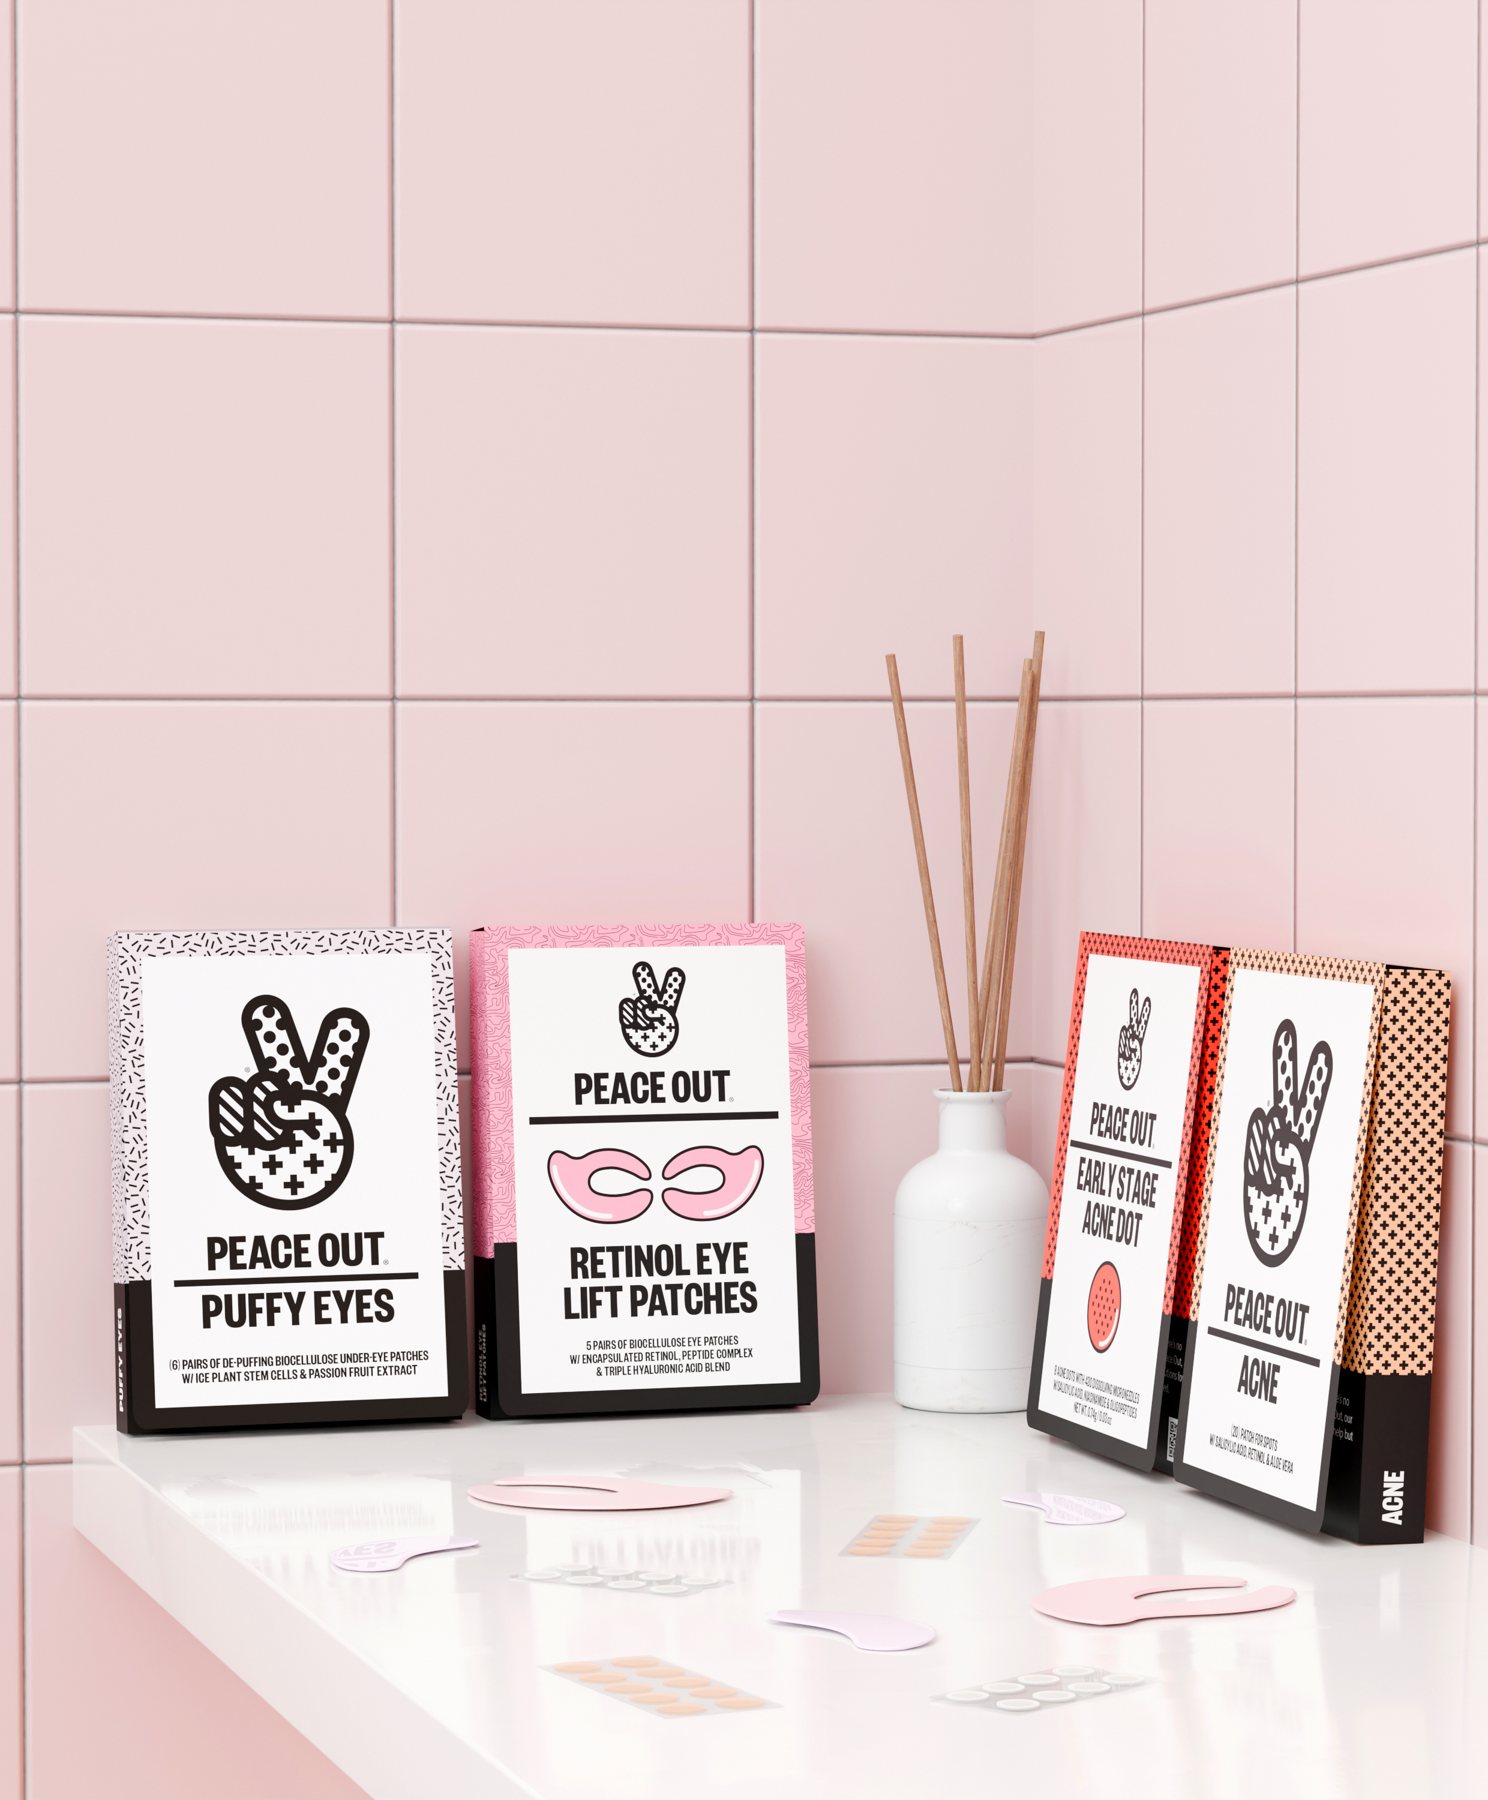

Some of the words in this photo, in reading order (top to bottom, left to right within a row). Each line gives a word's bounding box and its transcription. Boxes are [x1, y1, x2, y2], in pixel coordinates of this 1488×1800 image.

[574, 1071, 666, 1105] PEACE
[1090, 1101, 1130, 1142] PEACE
[1129, 1110, 1157, 1148] OUT
[1076, 1156, 1117, 1198] EARLY
[1116, 1165, 1159, 1208] STAGE
[1082, 1200, 1116, 1241] ACNE
[1115, 1208, 1143, 1247] DOT
[207, 1234, 312, 1271] PEACE
[570, 1243, 691, 1279] RETINOL
[696, 1241, 749, 1275] EYE
[201, 1291, 306, 1329] PUFFY
[313, 1288, 395, 1325] EYES
[563, 1285, 623, 1320] LIFT
[630, 1280, 758, 1318] PATCHES
[1224, 1283, 1275, 1335] PEACE
[1275, 1298, 1310, 1345] OUT
[169, 1359, 180, 1371] (6)
[182, 1358, 209, 1370] PAIRS
[210, 1357, 221, 1369] OF
[222, 1355, 274, 1369] DE-PUFFING
[275, 1354, 339, 1366] BIOCELLULOSE
[340, 1352, 389, 1364] UNDER-EYE
[390, 1350, 429, 1362] PATCHES
[570, 1354, 580, 1364] W/
[582, 1352, 643, 1364] ENCAPSULATED
[645, 1351, 681, 1362] RETINOL,
[682, 1349, 715, 1360] PEPTIDE
[716, 1348, 754, 1359] COMPLEX
[586, 1341, 591, 1351] 5
[593, 1339, 616, 1350] PAIRS
[617, 1339, 627, 1349] OF
[629, 1337, 686, 1349] BIOCELLULOSE
[687, 1336, 701, 1347] EYE
[704, 1335, 739, 1346] PATCHES
[181, 1372, 193, 1384] W/
[195, 1372, 210, 1383] ICE
[211, 1371, 242, 1383] PLANT
[243, 1370, 269, 1382] STEM
[270, 1369, 298, 1381] CELLS
[299, 1369, 307, 1379] &
[309, 1367, 347, 1379] PASSION
[349, 1366, 375, 1377] FRUIT
[377, 1364, 418, 1376] EXTRACT
[596, 1366, 603, 1377] &
[604, 1365, 632, 1376] TRIPLE
[633, 1363, 684, 1375] HYALURONIC
[685, 1362, 703, 1373] ACID
[705, 1361, 731, 1372] BLEND
[1057, 1366, 1066, 1379] ACNE
[1066, 1369, 1076, 1382] DOTS
[1237, 1354, 1281, 1405] ACNE
[1342, 1397, 1350, 1406] no
[1215, 1435, 1236, 1454] SALICYLIC
[1248, 1447, 1265, 1464] RETINOL
[1270, 1455, 1282, 1470] ALOE
[1282, 1458, 1294, 1474] VERA
[1240, 1427, 1255, 1443] PATCH
[1255, 1432, 1263, 1447] FOR
[1263, 1436, 1278, 1452] SPOTS
[1344, 1431, 1354, 1442] but
[1381, 1470, 1405, 1526] ACNE
